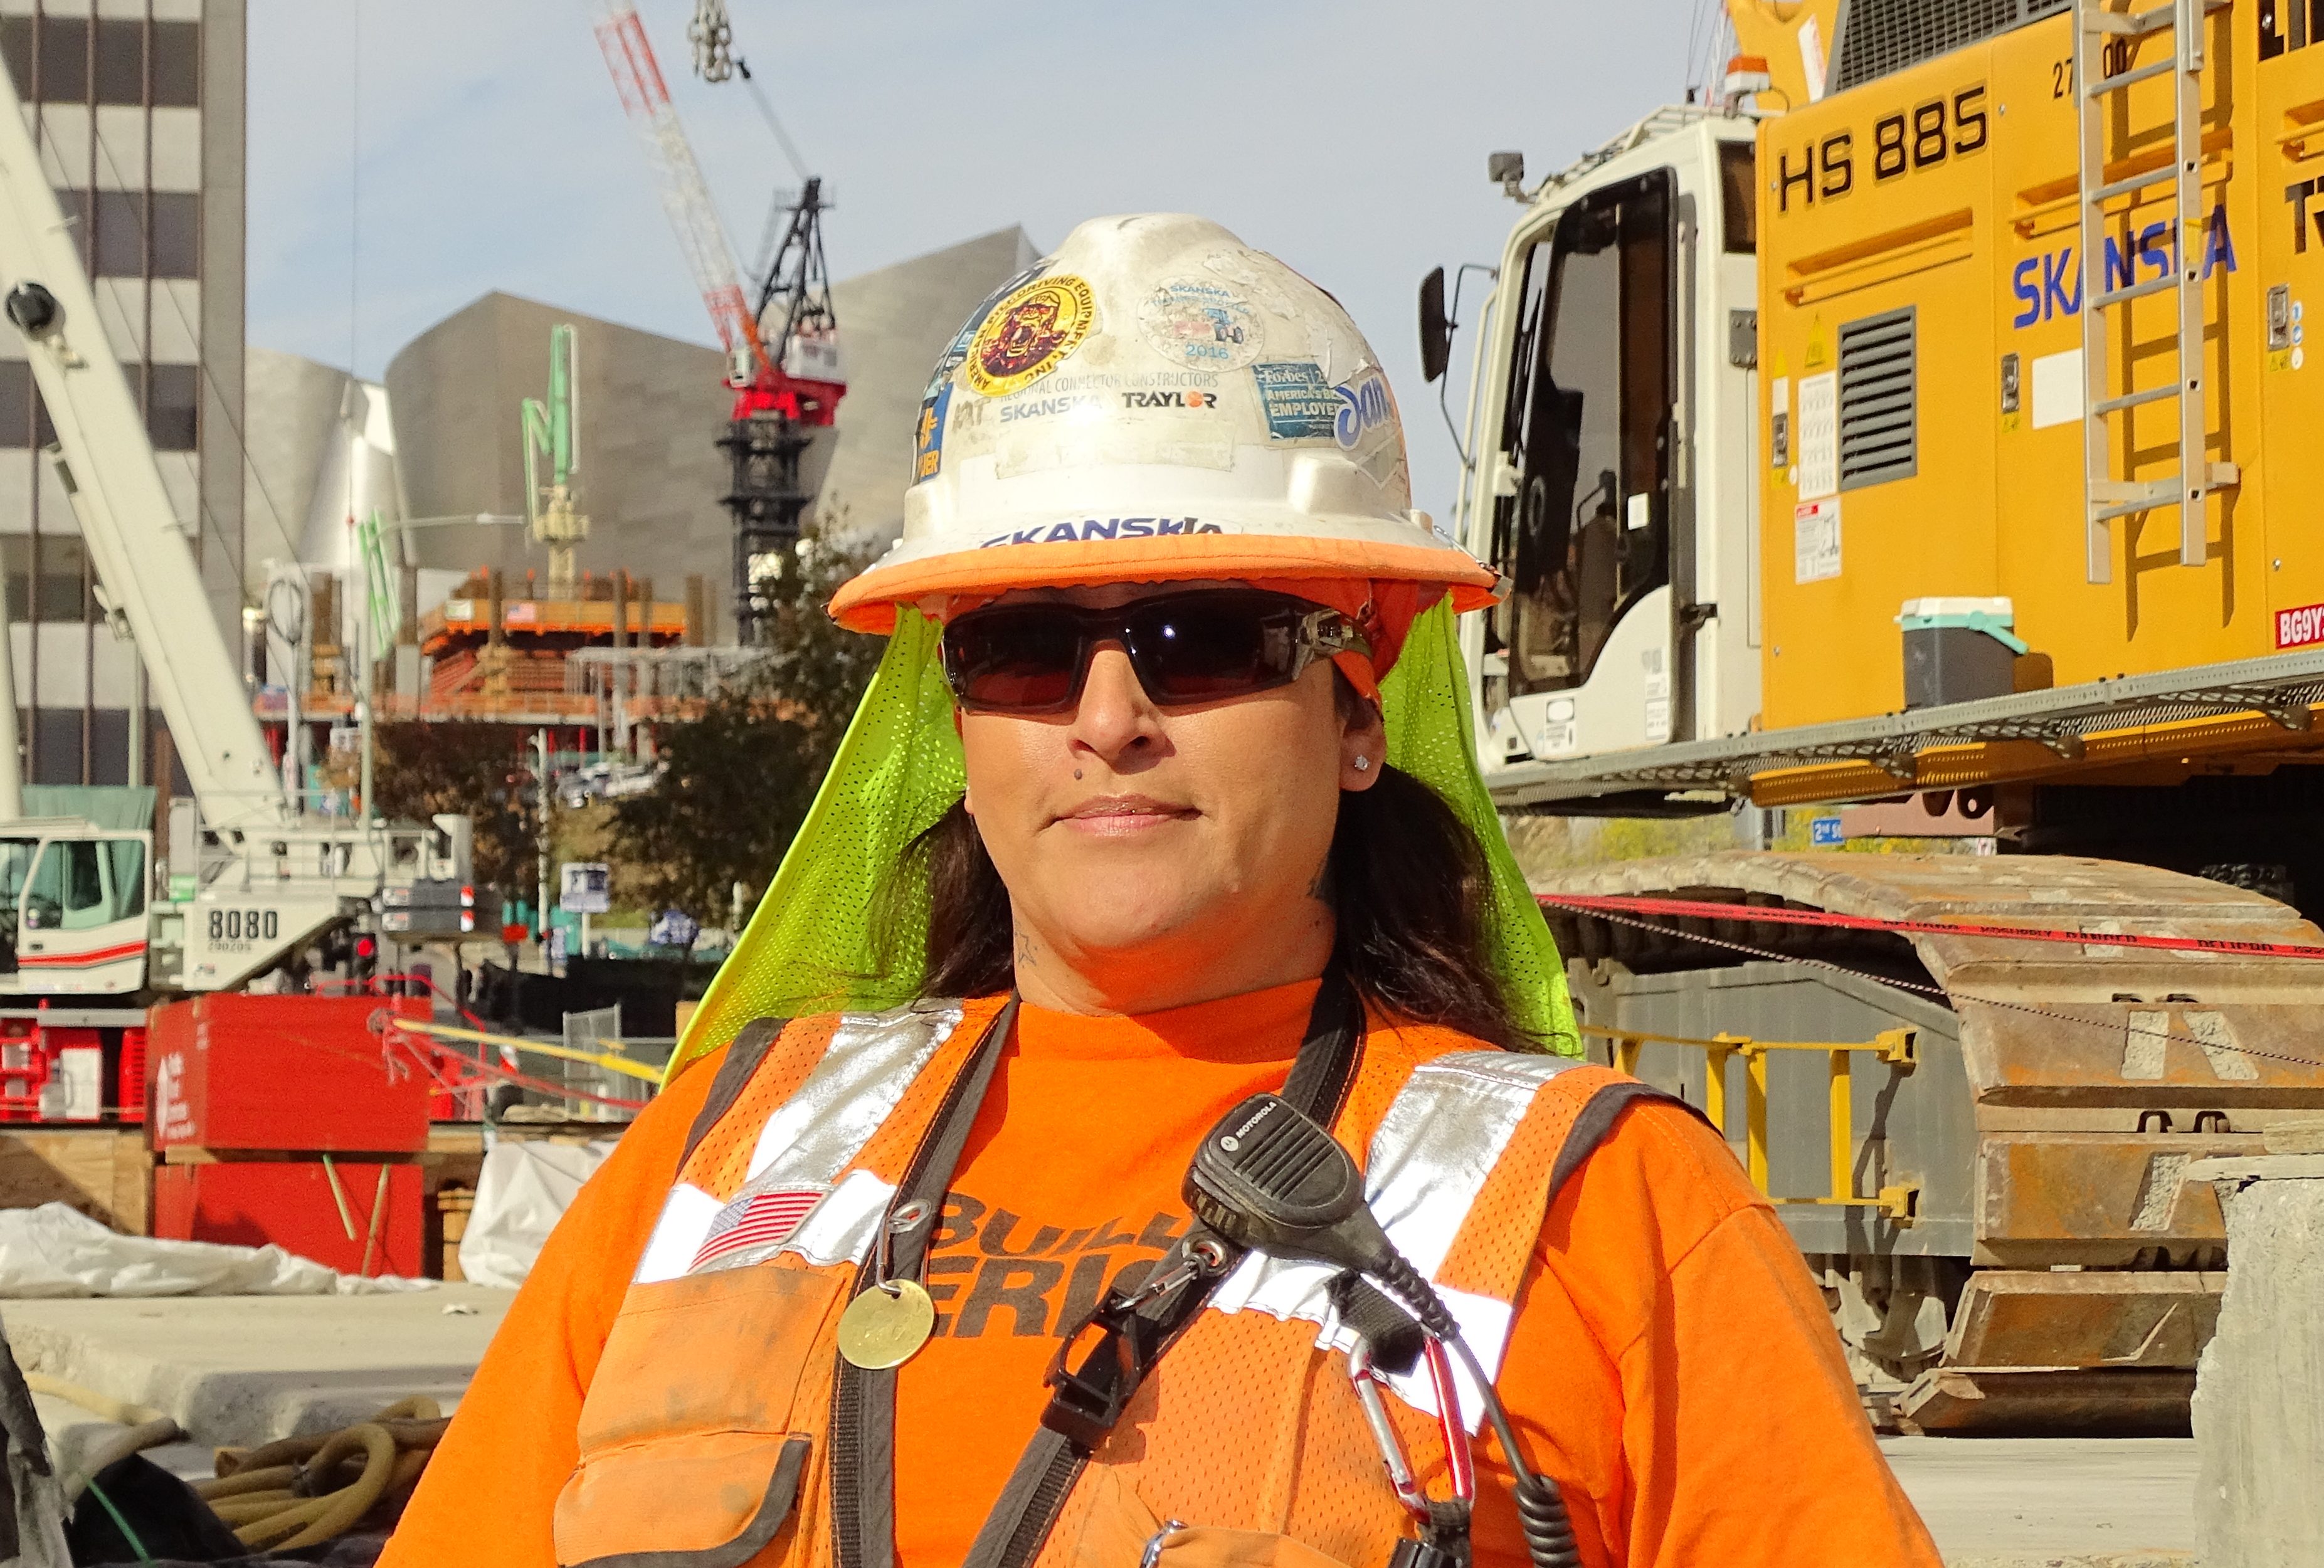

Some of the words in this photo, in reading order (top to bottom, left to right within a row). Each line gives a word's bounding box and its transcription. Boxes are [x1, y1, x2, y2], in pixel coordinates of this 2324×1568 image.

[1780, 134, 1852, 211] HS
[1875, 85, 1987, 179] 885
[2013, 204, 2237, 329] SKNSA
[1170, 285, 1230, 298] SKANSKA
[970, 329, 991, 390] AMERICAN
[1185, 344, 1229, 360] 2016
[1125, 371, 1218, 388] CONSTRUCTORS
[1264, 369, 1307, 384] Forbes
[1000, 395, 1103, 423] SKANSKA
[1121, 391, 1217, 409] TRAYLOR
[208, 910, 278, 940] 8080
[1235, 1102, 1277, 1139] MOTOROLA
